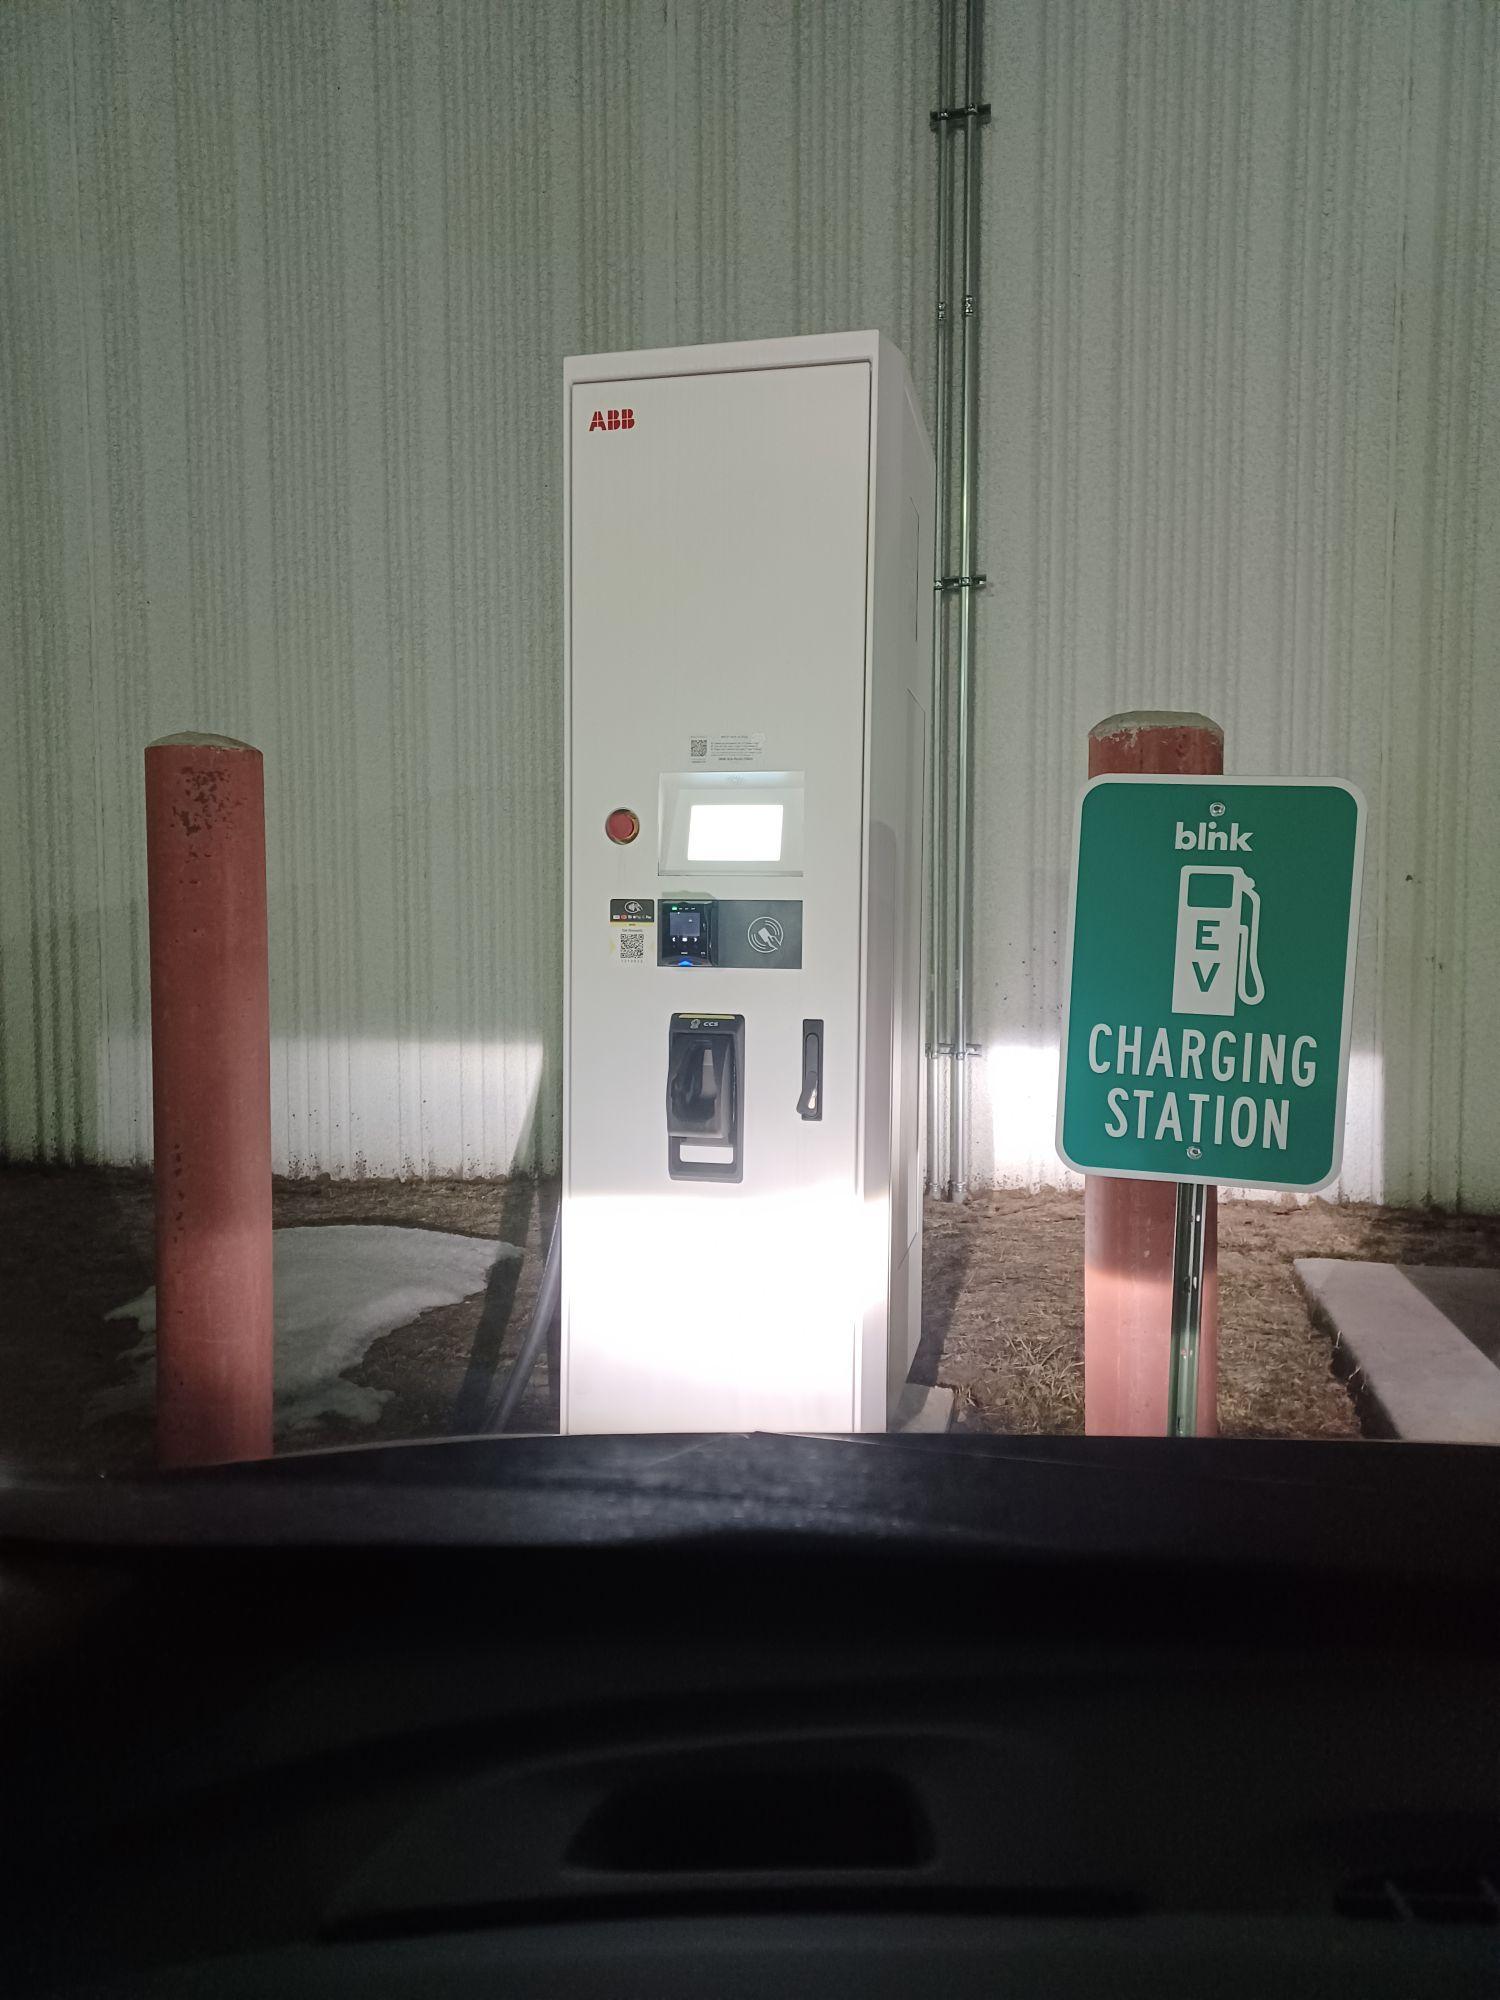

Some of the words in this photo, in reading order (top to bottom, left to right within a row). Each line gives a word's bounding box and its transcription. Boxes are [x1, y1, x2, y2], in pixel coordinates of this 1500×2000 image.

[589, 408, 636, 432] ABB
[1174, 822, 1254, 851] blink
[1088, 1023, 1318, 1088] CHARGING
[1104, 1087, 1290, 1150] STATION
